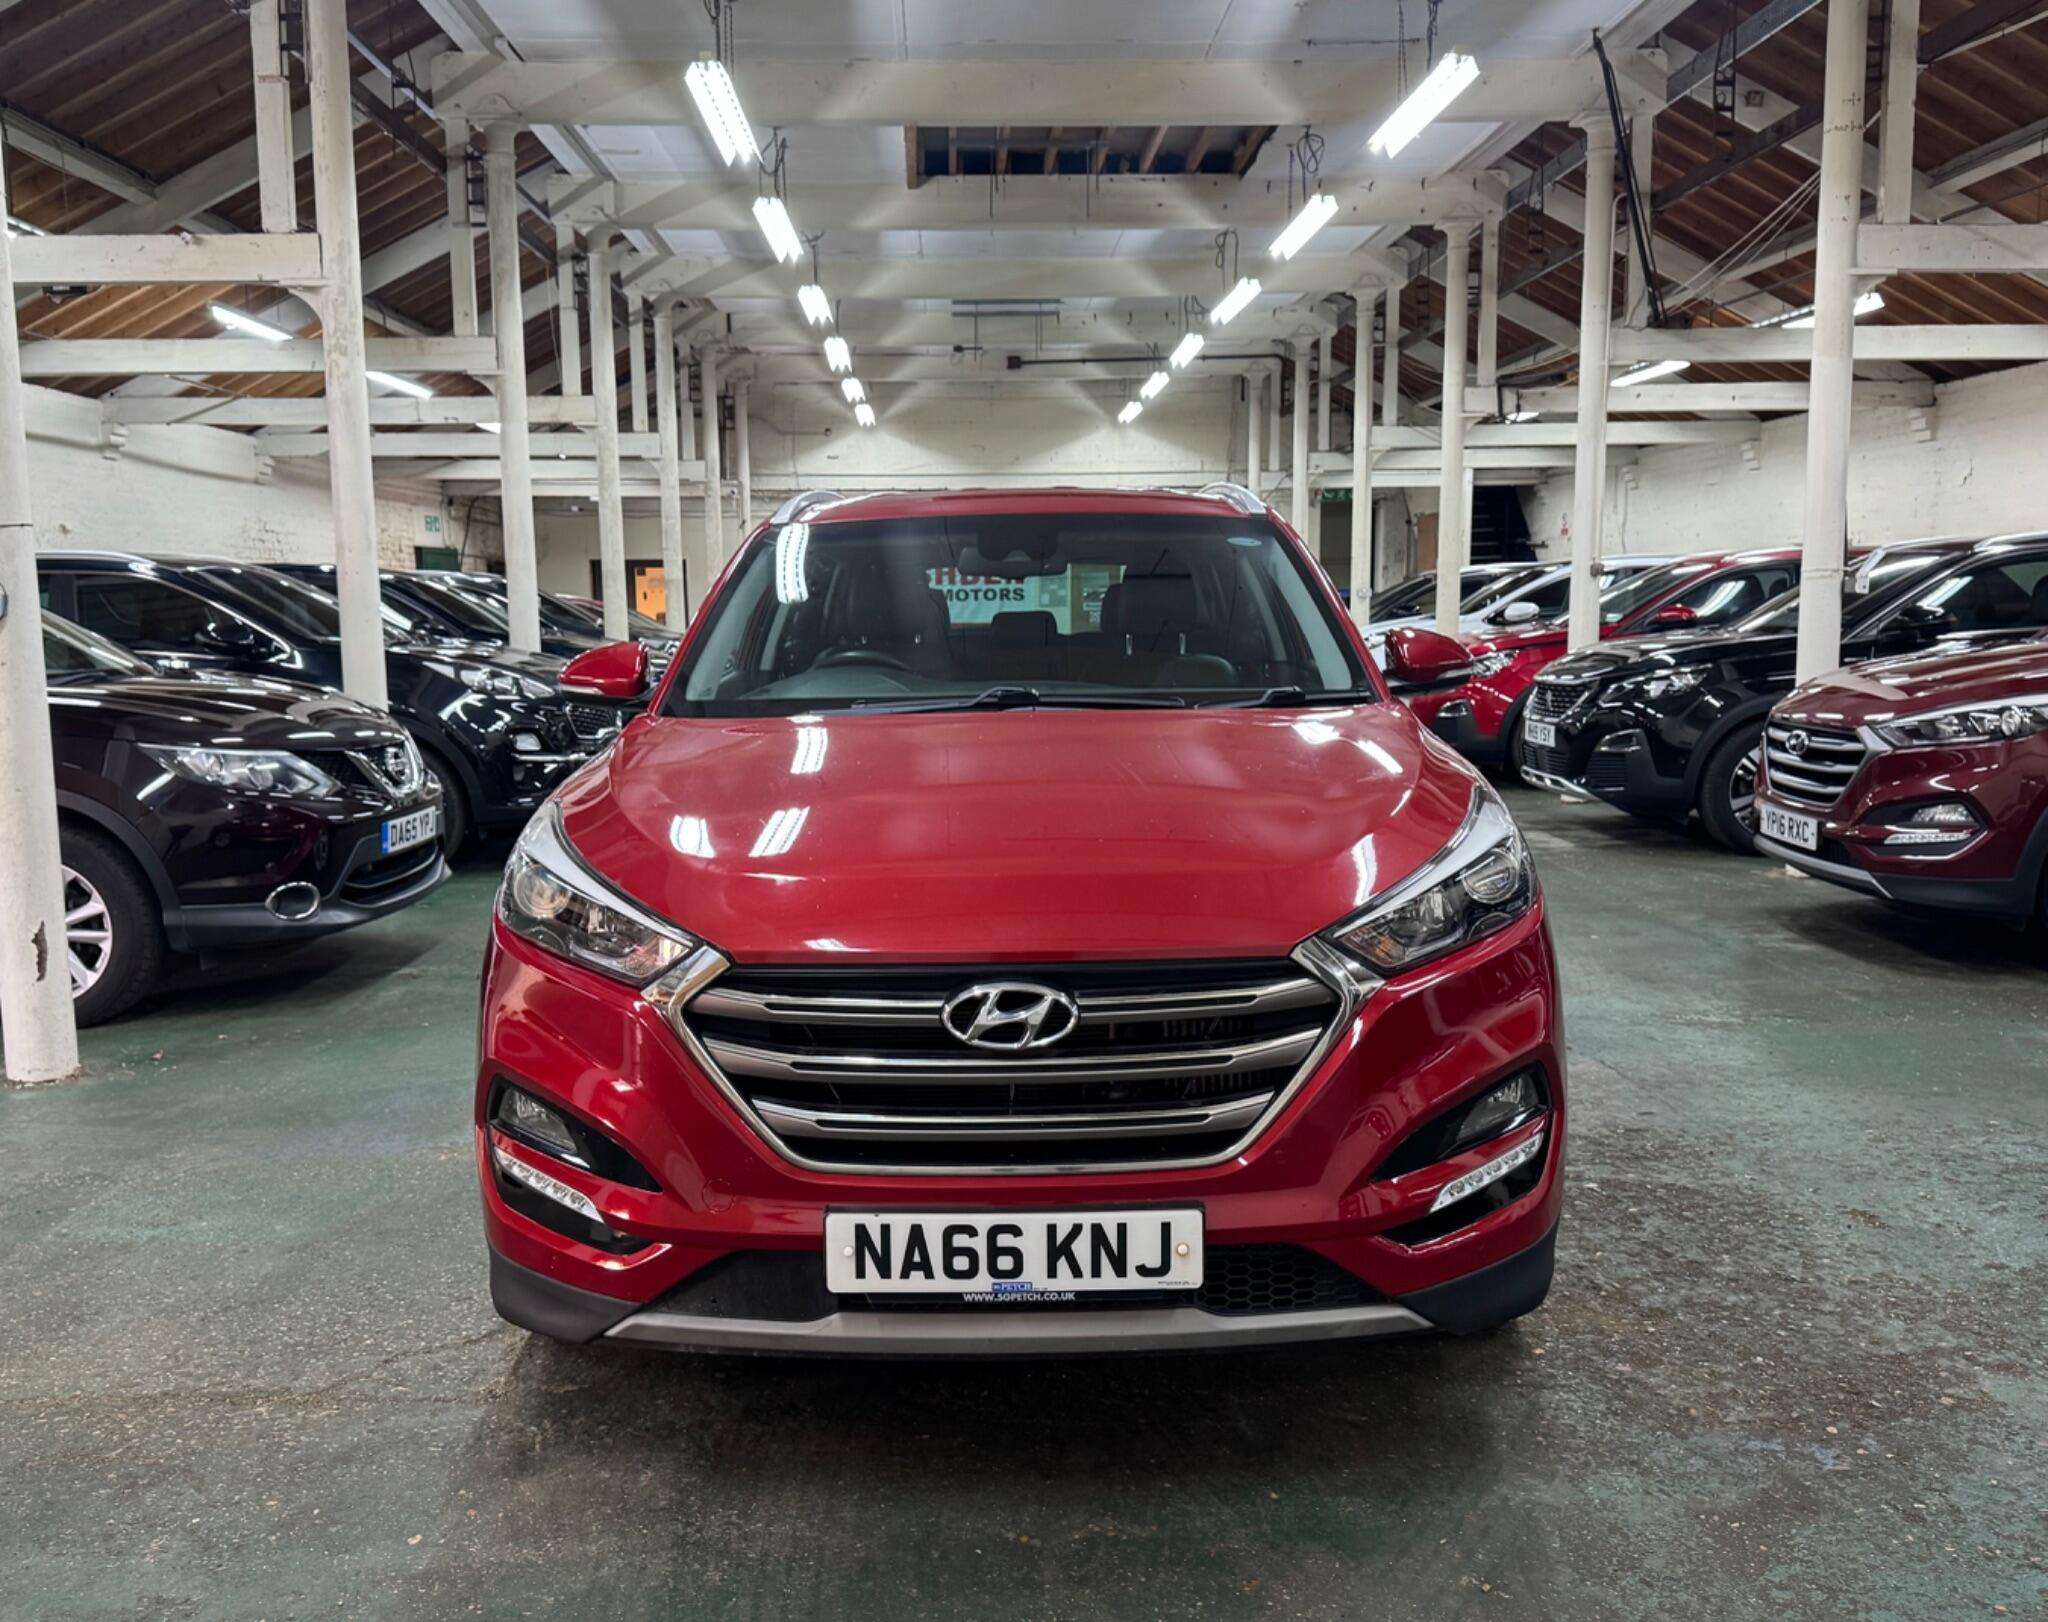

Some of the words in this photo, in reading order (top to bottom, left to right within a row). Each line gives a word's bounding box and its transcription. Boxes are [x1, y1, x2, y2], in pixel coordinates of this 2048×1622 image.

[391, 817, 417, 847] DA65
[420, 811, 436, 837] YPJ
[1766, 809, 1786, 835] YP16
[1788, 817, 1809, 842] RXC
[854, 1223, 1024, 1279] NA66
[1046, 1221, 1172, 1279] KNJ
